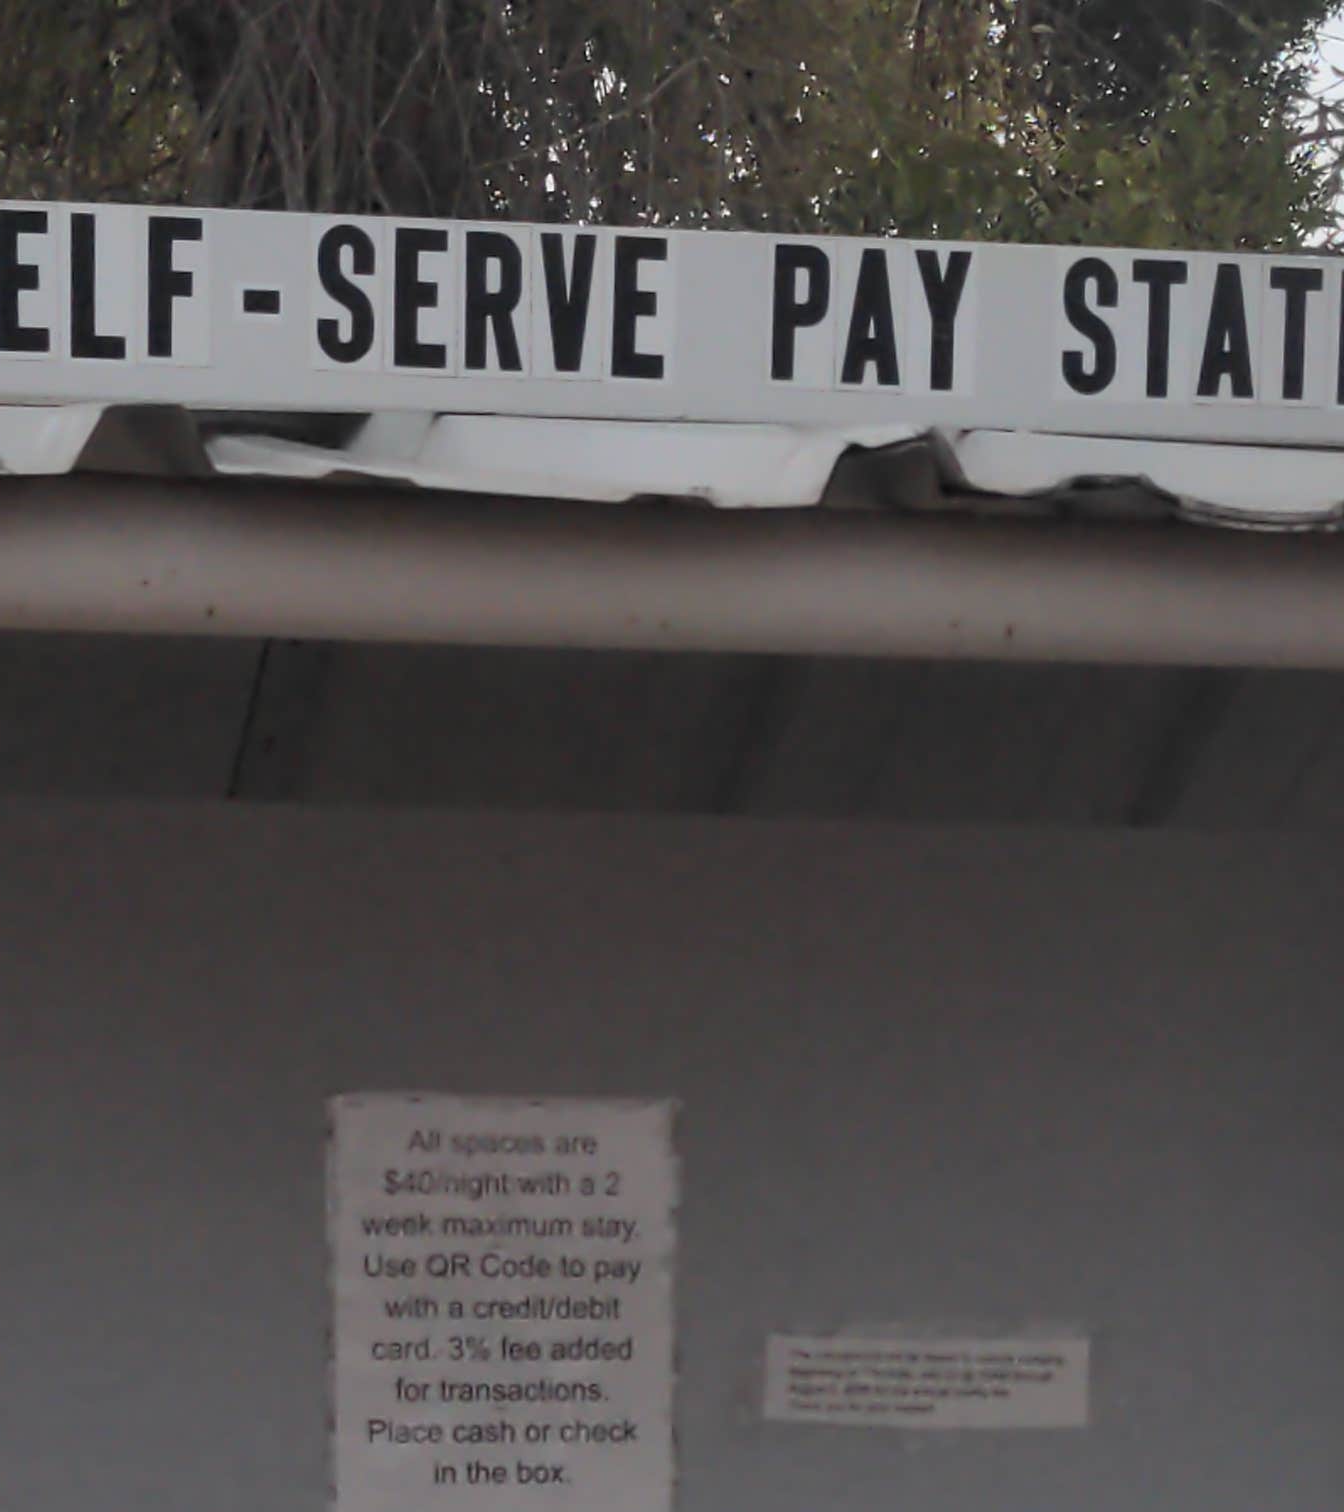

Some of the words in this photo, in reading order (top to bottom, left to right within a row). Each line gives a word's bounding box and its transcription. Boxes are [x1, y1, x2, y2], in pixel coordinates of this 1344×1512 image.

[770, 244, 972, 392] PAY
[408, 1132, 440, 1153] All
[451, 1133, 544, 1157] spaces
[556, 1135, 597, 1153] are
[518, 1172, 570, 1195] with
[580, 1177, 595, 1195] a
[606, 1172, 620, 1195] 2
[361, 1214, 432, 1236] week
[442, 1216, 573, 1237] maximum
[363, 1255, 416, 1278] Use
[426, 1255, 471, 1278] QR
[481, 1254, 552, 1278] Code
[560, 1256, 586, 1278] to
[594, 1257, 641, 1285] pay
[385, 1297, 438, 1319] with
[449, 1302, 463, 1319] a
[473, 1296, 620, 1320] credit/debit
[371, 1338, 436, 1360] card.
[448, 1337, 490, 1360] 3%
[501, 1337, 541, 1361] fee
[550, 1337, 633, 1360] added
[396, 1378, 430, 1401] for
[440, 1379, 608, 1402] transactions.
[367, 1419, 442, 1443] Place
[452, 1420, 515, 1443] cash
[525, 1425, 551, 1442] or
[560, 1420, 638, 1443] check
[434, 1462, 457, 1484] in
[466, 1461, 508, 1484] the
[517, 1462, 571, 1484] box.
